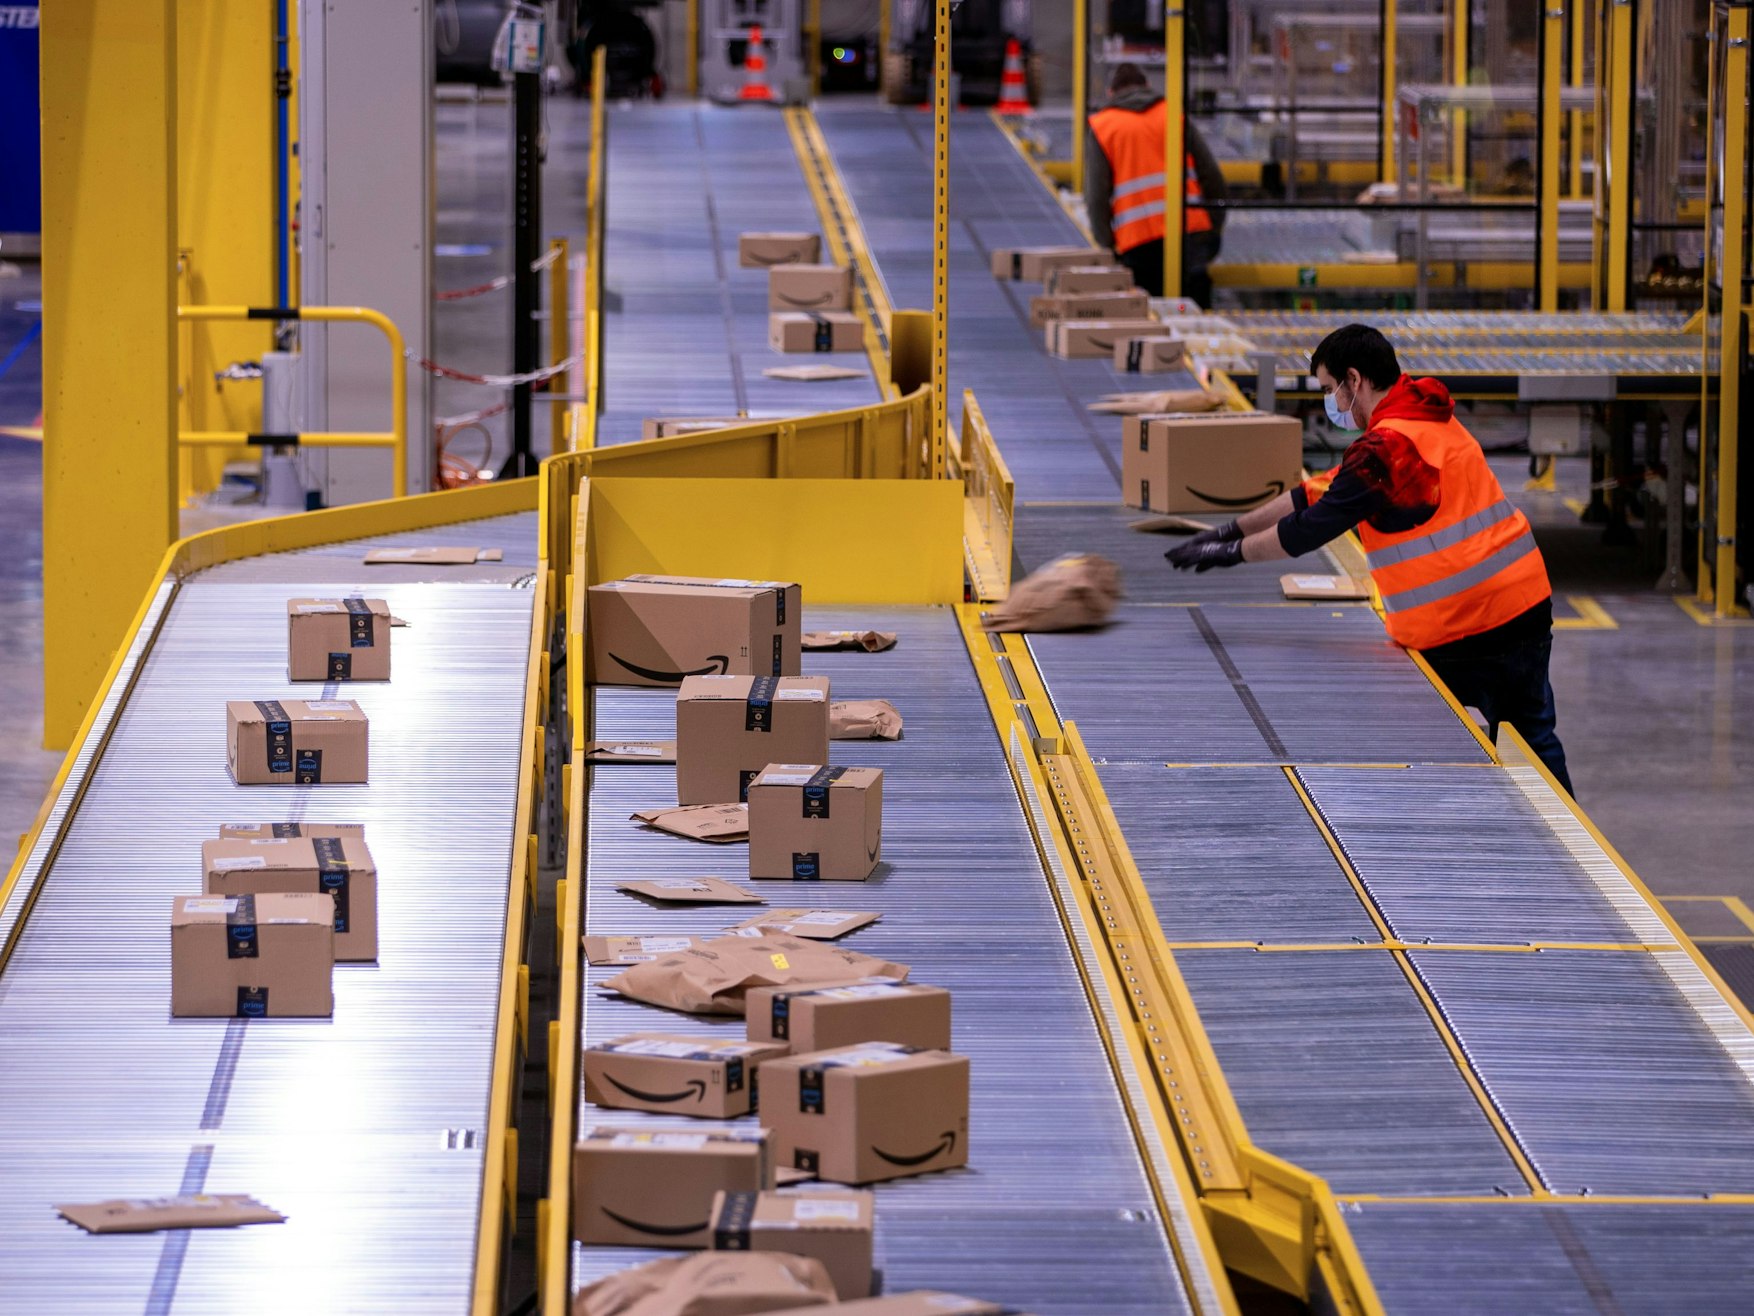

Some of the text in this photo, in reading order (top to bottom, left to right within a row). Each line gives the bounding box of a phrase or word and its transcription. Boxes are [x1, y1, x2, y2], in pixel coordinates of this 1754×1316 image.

[271, 722, 289, 730] prime
[323, 874, 343, 882] prime
[233, 926, 254, 934] prime
[243, 1002, 265, 1010] prime
